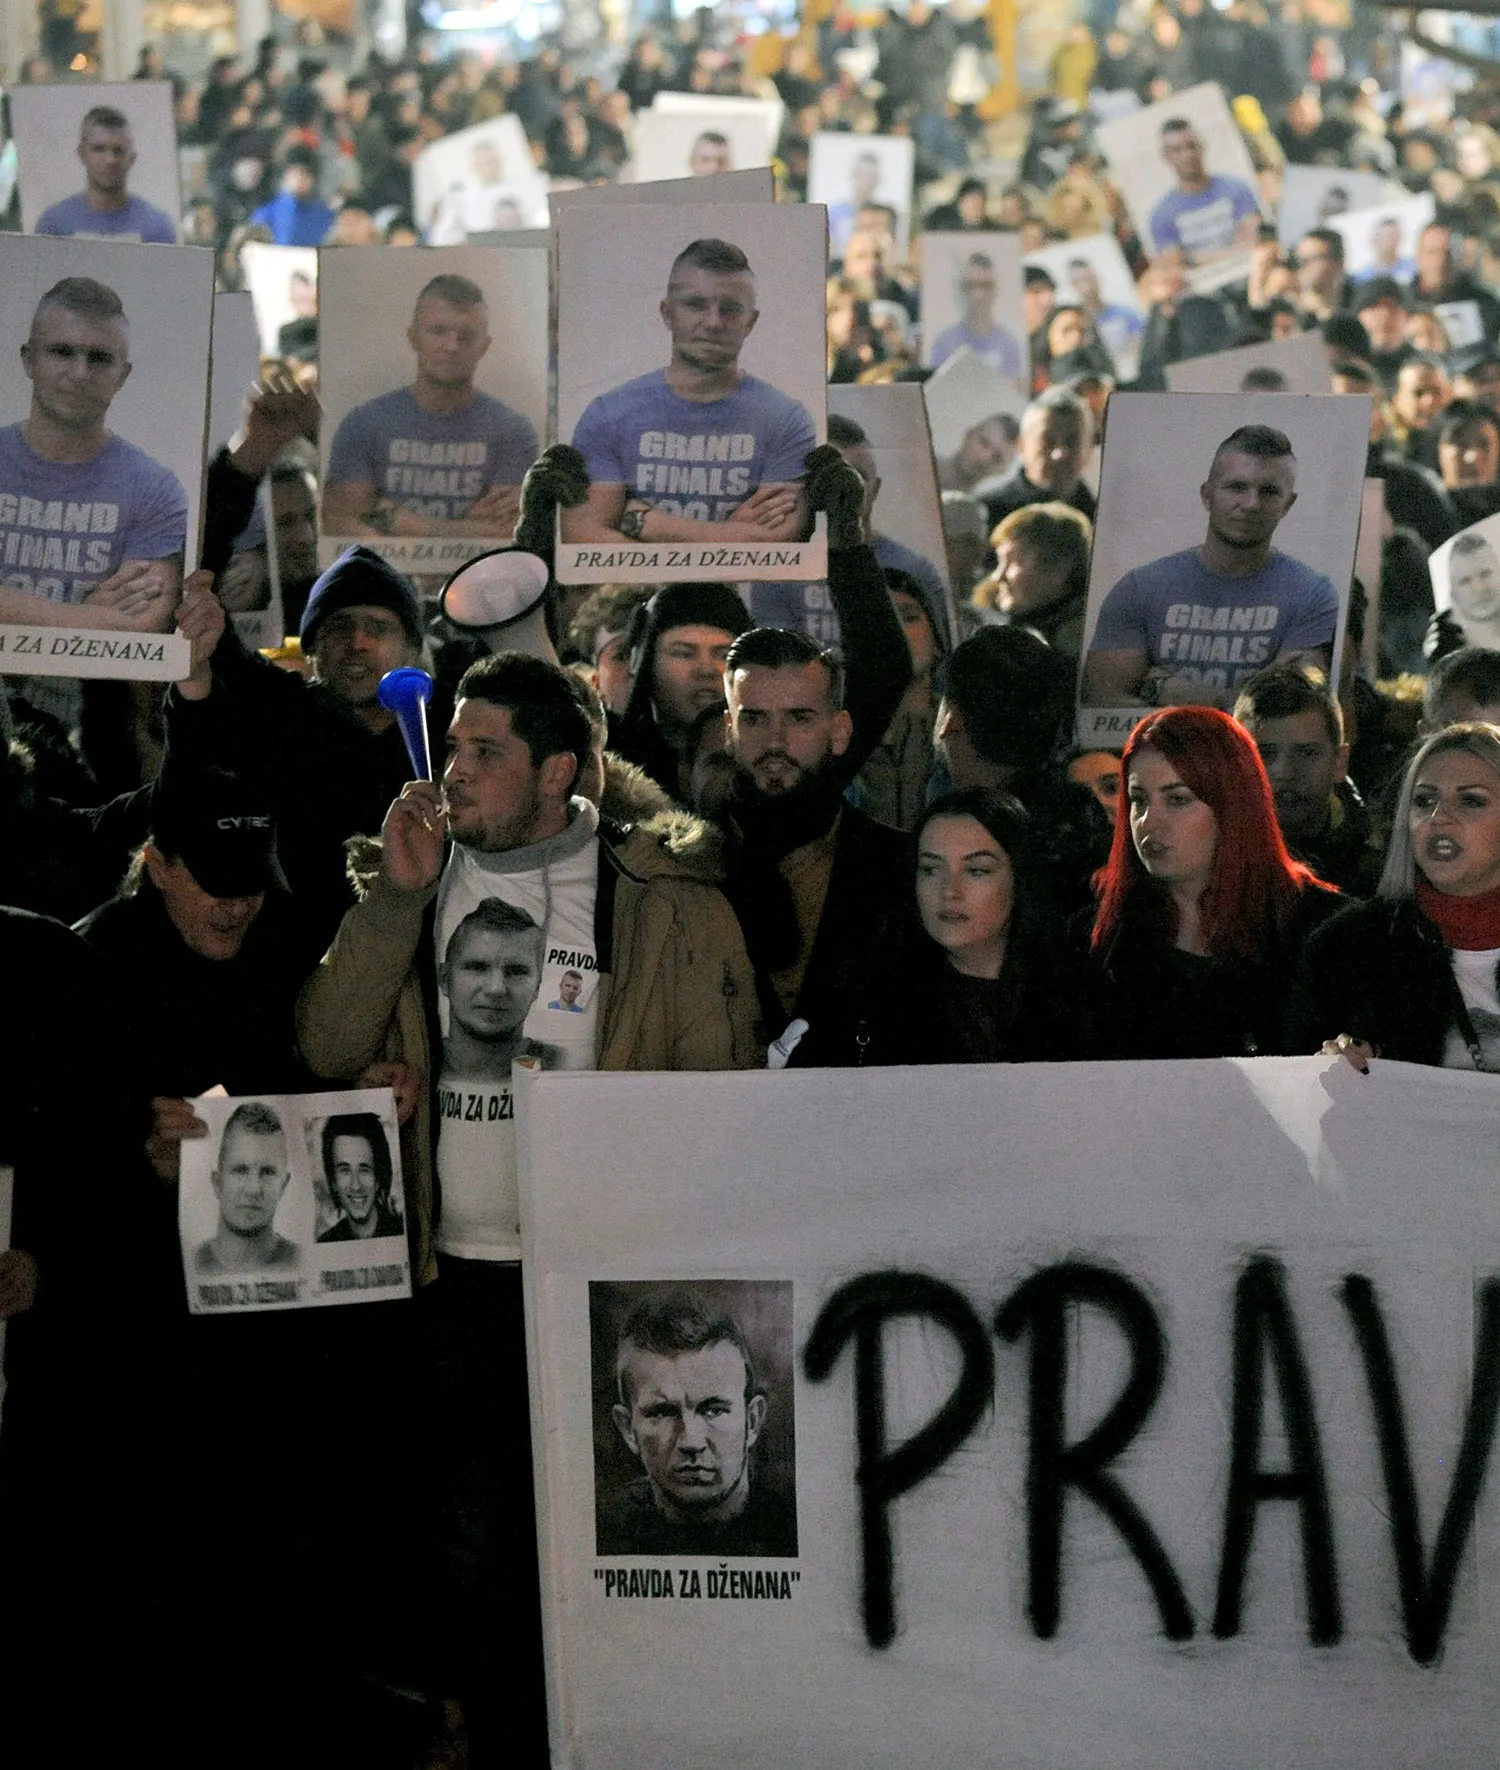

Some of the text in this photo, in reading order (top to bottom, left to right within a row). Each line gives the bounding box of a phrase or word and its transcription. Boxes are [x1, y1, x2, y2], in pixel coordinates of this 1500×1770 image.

[639, 431, 755, 461] GRAND
[636, 464, 750, 496] FINALS
[0, 531, 111, 574] INALS
[574, 548, 801, 567] PRAVDA ZA DŽENANA
[1165, 603, 1279, 632] GRAND
[13, 635, 43, 654] ZA
[50, 635, 164, 661] DŽENANA
[1160, 633, 1271, 664] FINALS
[465, 1094, 483, 1121] ZA
[594, 1563, 801, 1600] "PRAVDA ZA DŽENANA"
